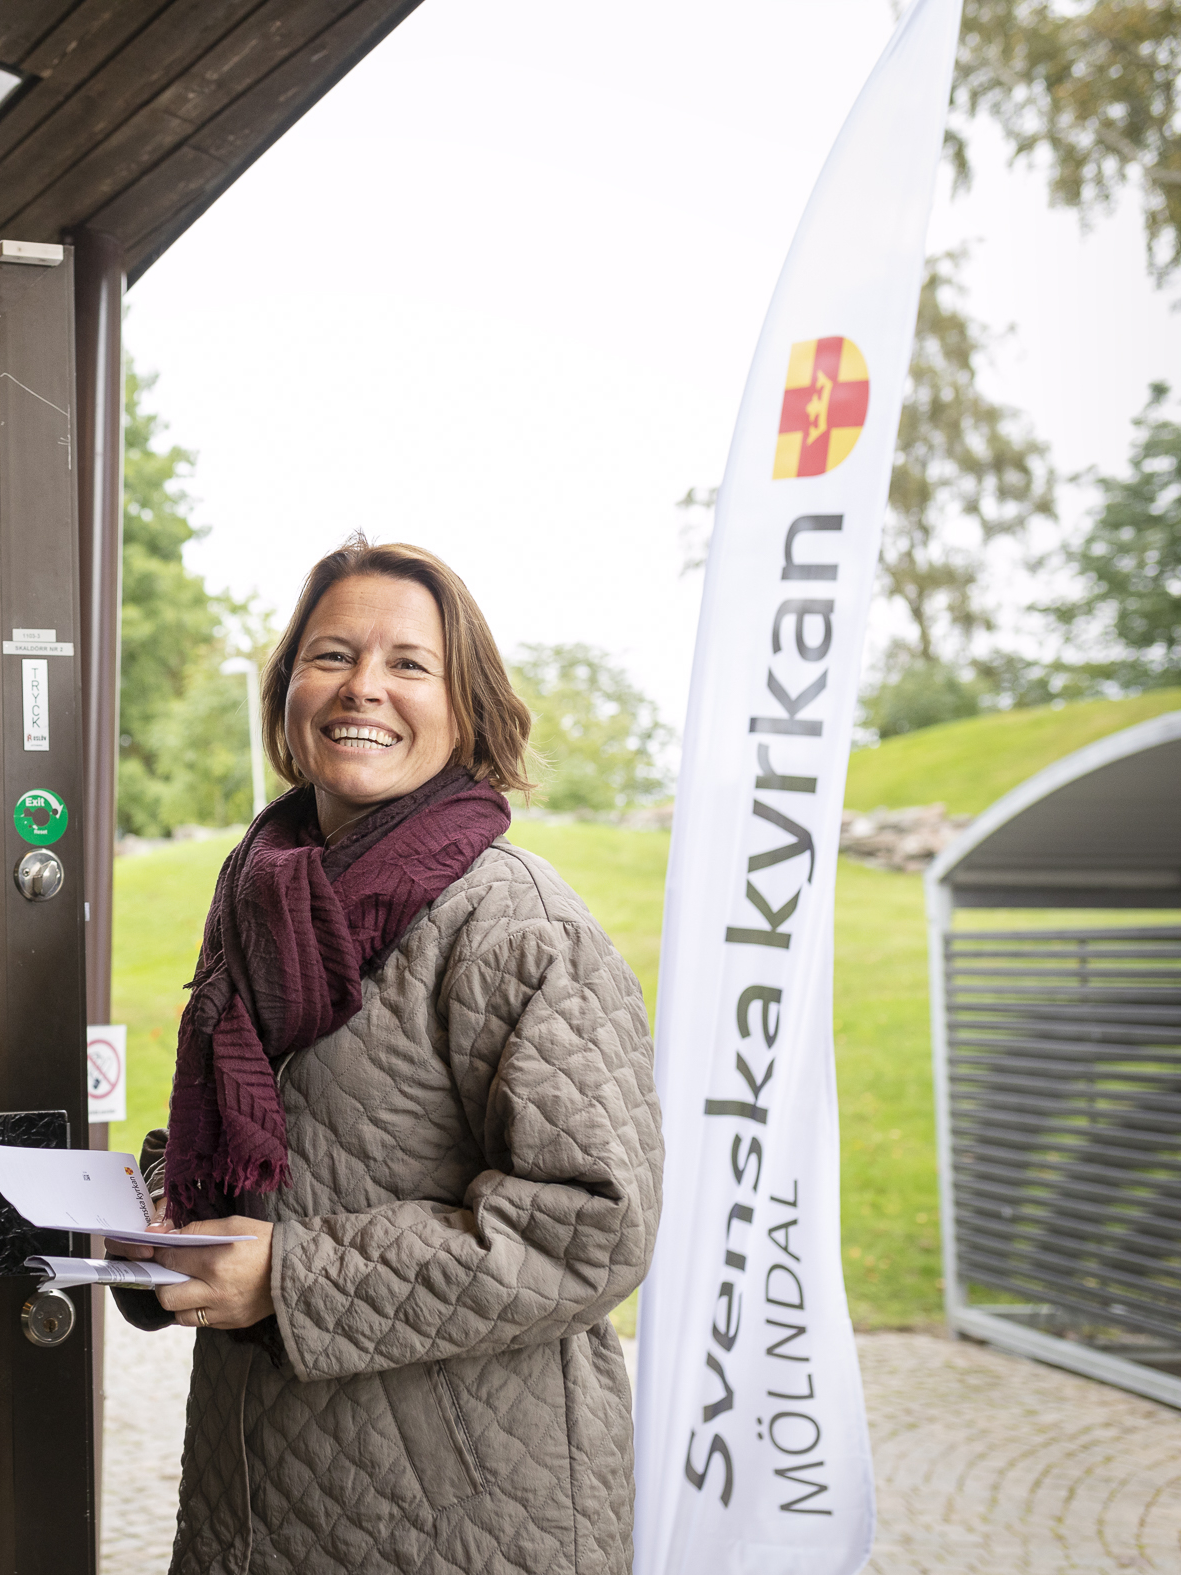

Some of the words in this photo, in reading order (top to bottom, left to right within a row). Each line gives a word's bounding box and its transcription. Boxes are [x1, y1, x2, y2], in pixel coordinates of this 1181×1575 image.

[31, 667, 41, 729] TRYCK
[724, 513, 845, 950] kyrkan
[25, 797, 45, 807] Exit
[129, 1176, 144, 1200] kyrkan
[139, 1200, 152, 1227] venska
[684, 984, 783, 1509] Svenska
[756, 1178, 833, 1516] MÖLNDAL
